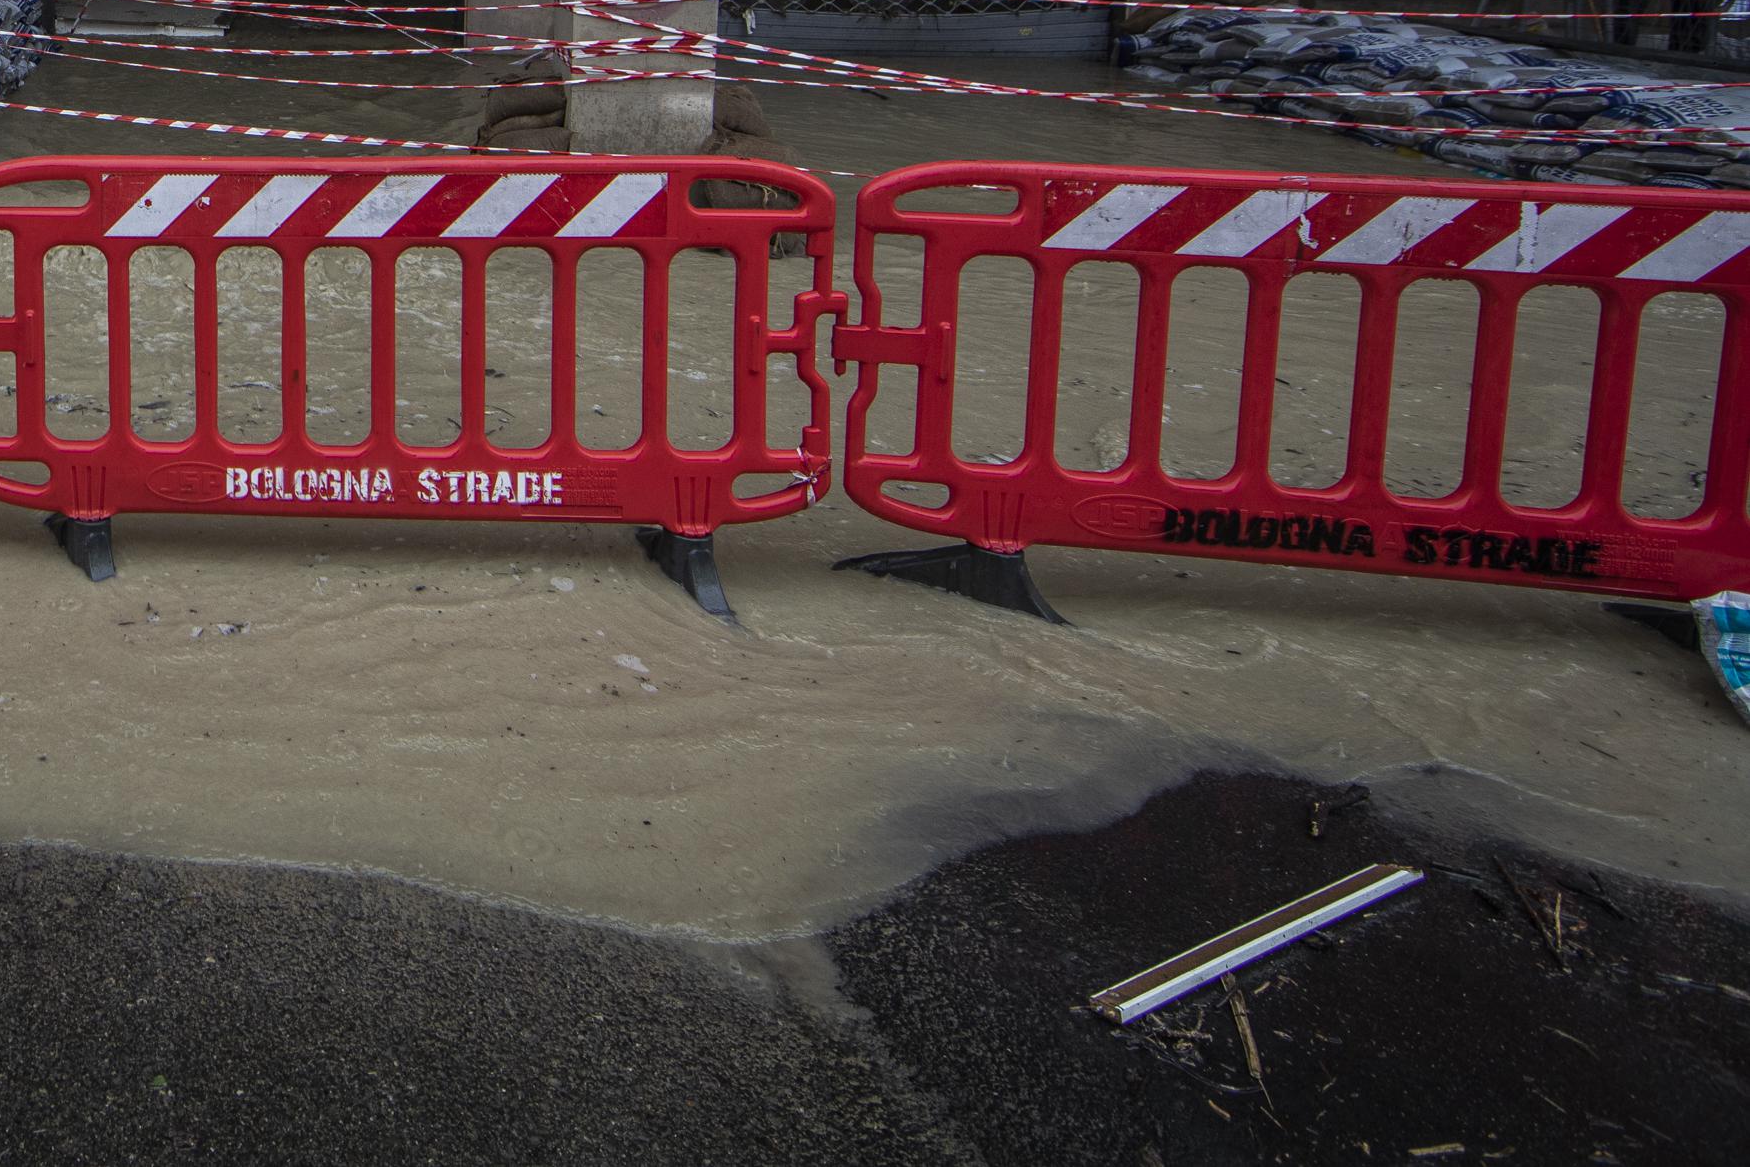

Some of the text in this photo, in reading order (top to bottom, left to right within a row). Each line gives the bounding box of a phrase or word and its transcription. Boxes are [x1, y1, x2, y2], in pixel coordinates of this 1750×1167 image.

[225, 466, 394, 503] BOLOGNA
[417, 467, 565, 505] STRADE
[1163, 508, 1377, 557] BOLOGNA
[1404, 527, 1602, 579] STRADE
